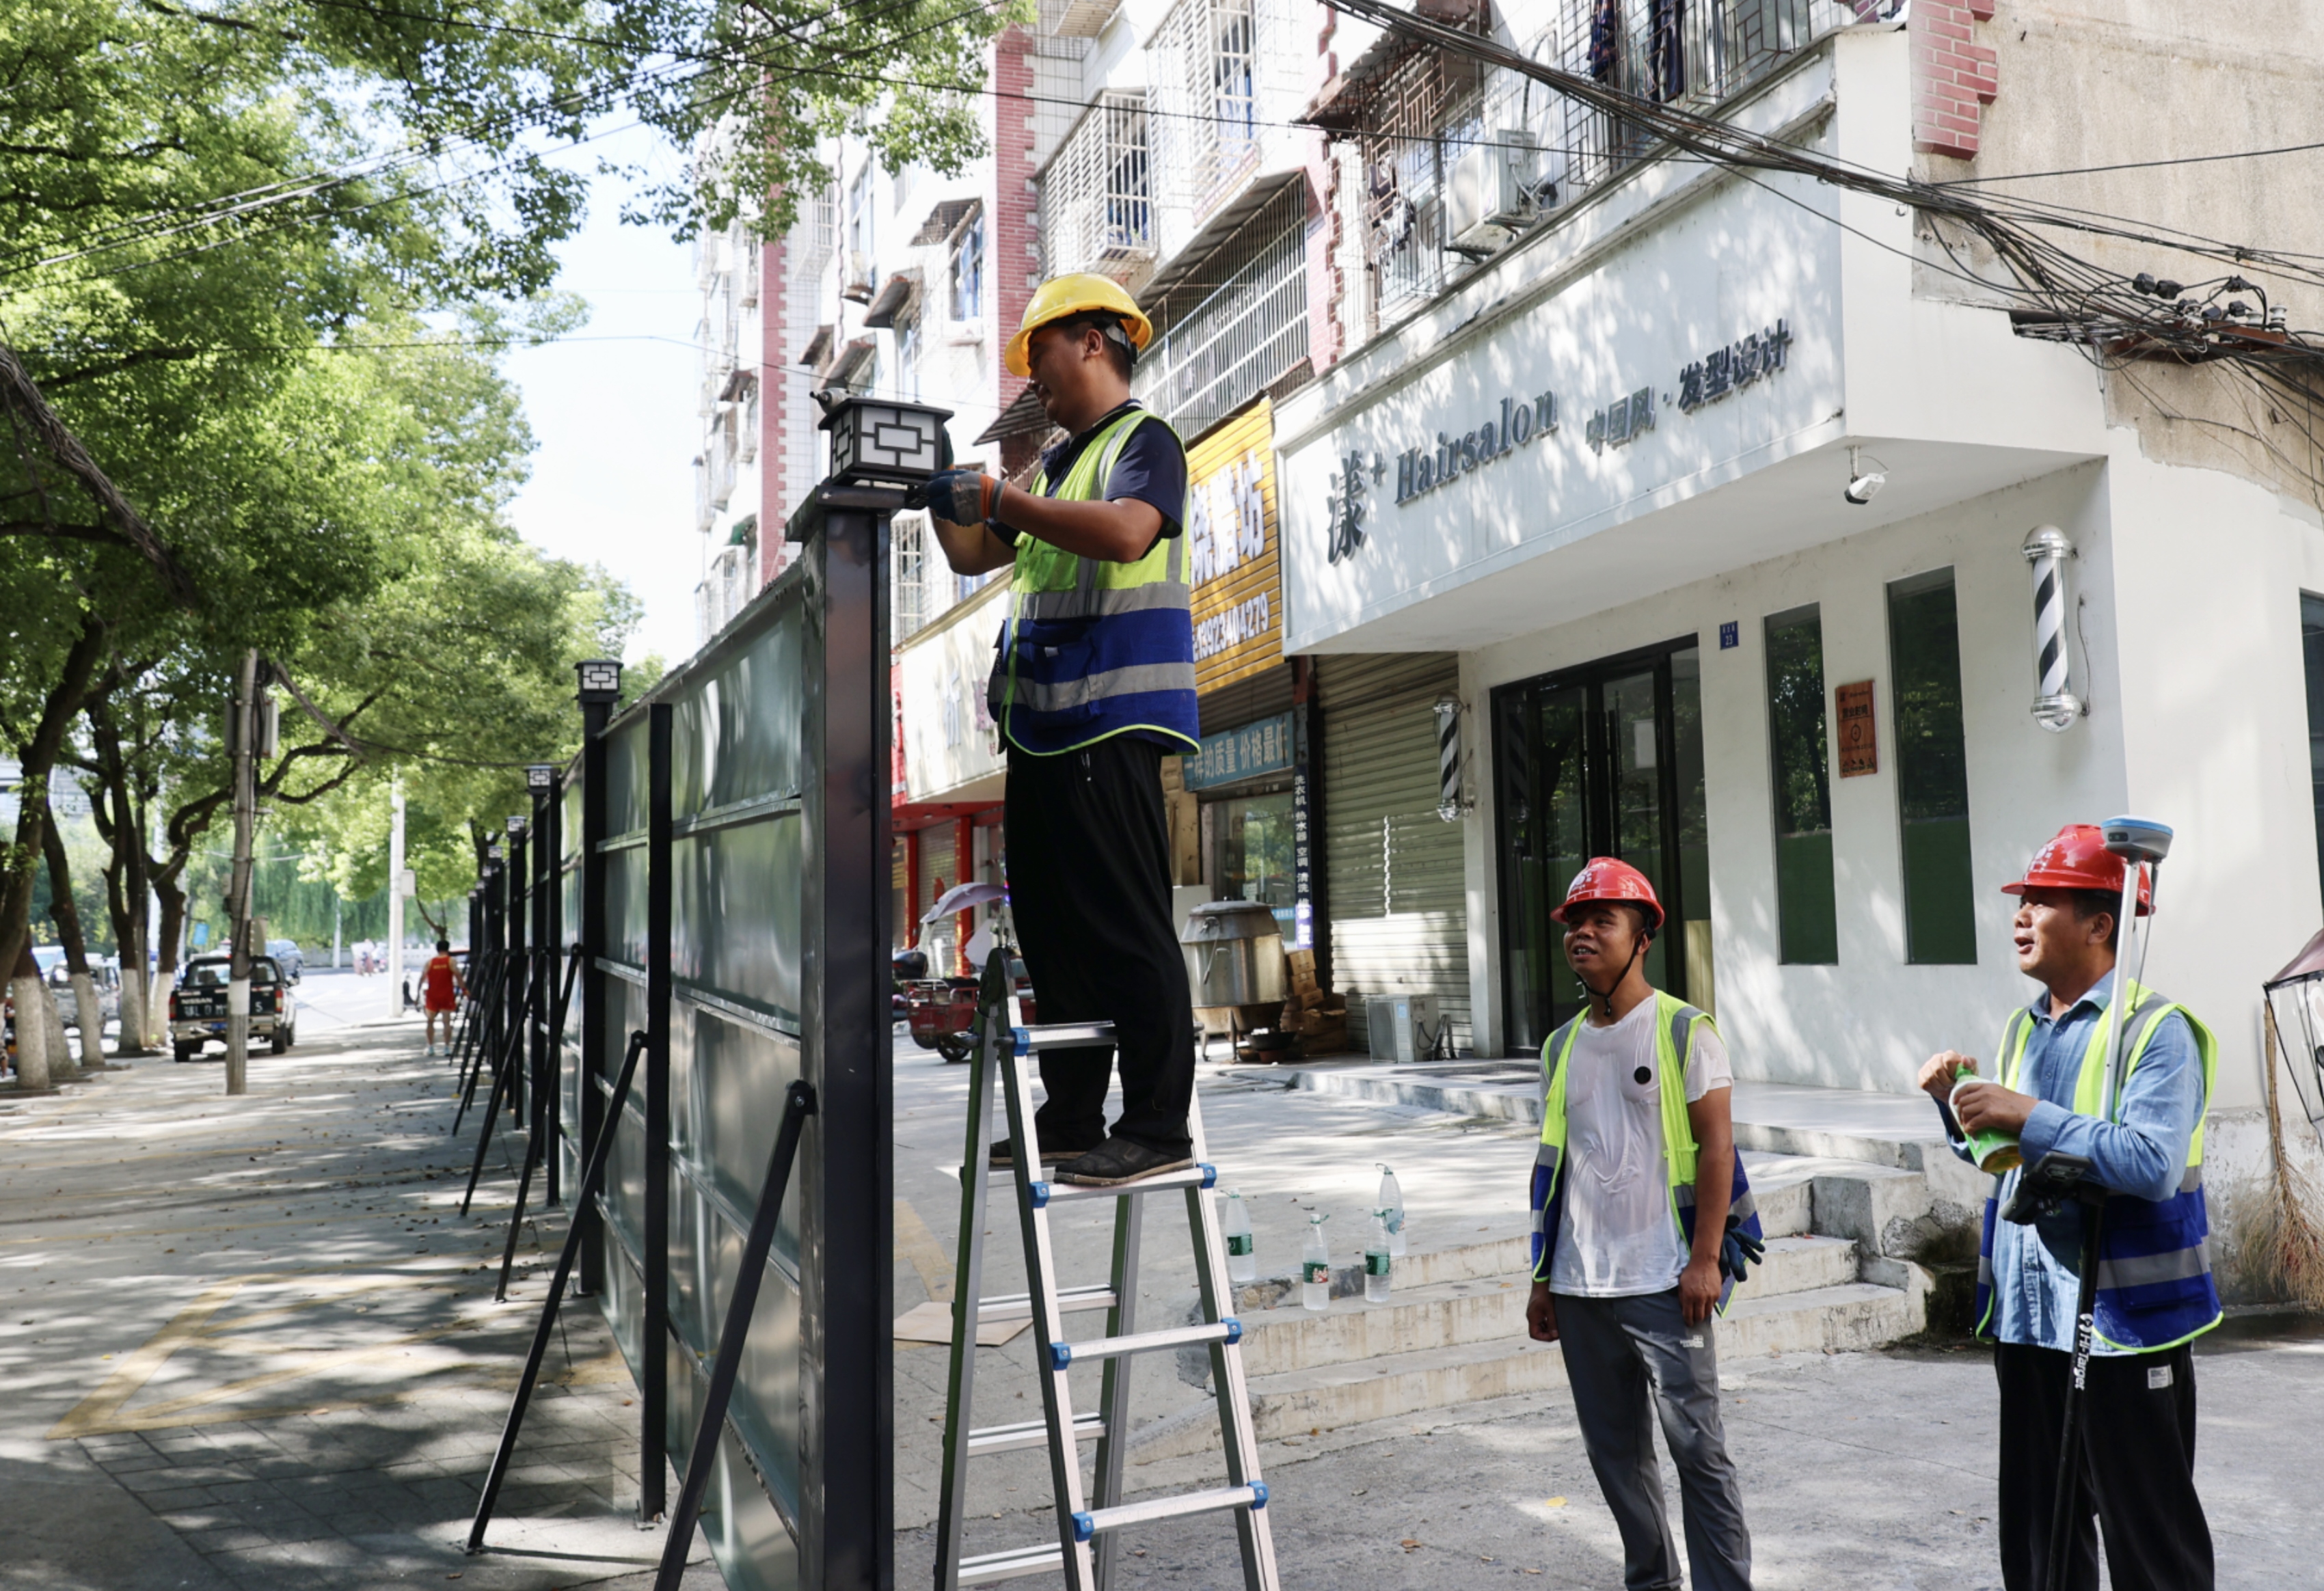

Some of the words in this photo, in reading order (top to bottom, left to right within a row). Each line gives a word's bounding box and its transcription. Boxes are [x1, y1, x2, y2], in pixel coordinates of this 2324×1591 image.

[1394, 390, 1558, 506] Hairsalon
[1725, 635, 1733, 646] 23
[1184, 737, 1237, 782] 一样的质量
[1240, 722, 1288, 770] 价格最低
[1294, 775, 1307, 805] 洗衣机
[1295, 811, 1308, 842] 热水器
[1296, 847, 1308, 867] 空调
[1297, 873, 1309, 893] 清洗
[2073, 1333, 2090, 1391] Hi-Target
